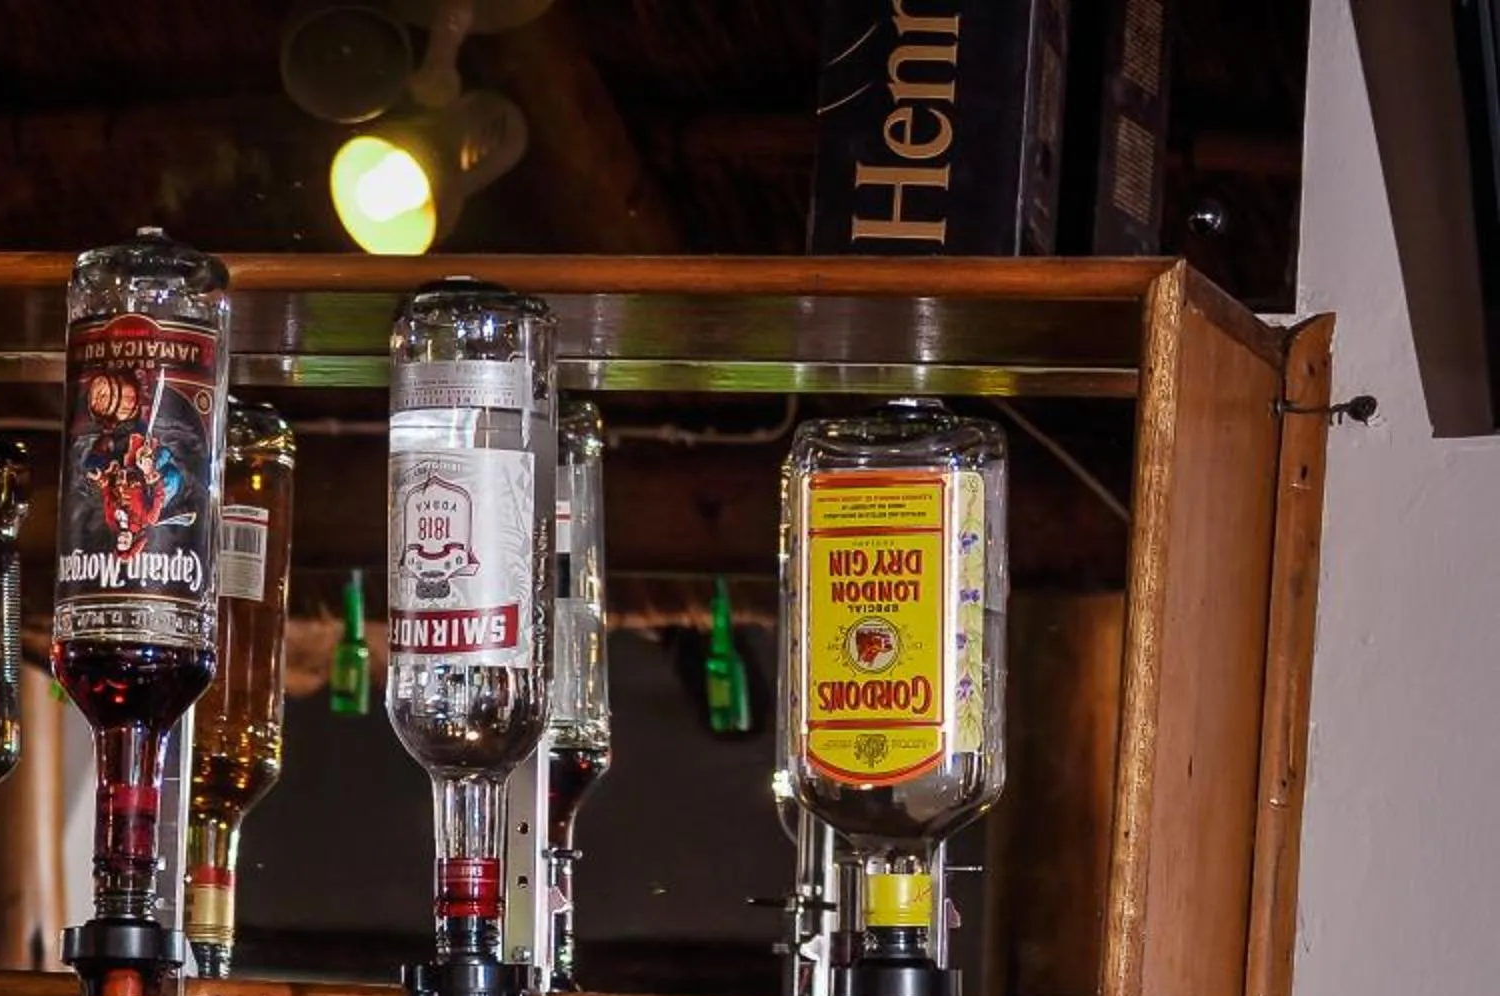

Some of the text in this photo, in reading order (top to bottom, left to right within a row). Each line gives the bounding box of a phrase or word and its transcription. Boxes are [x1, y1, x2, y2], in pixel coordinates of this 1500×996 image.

[82, 340, 200, 365] JAMAICA RU
[106, 358, 156, 369] BLACK
[418, 516, 451, 541] 1818
[125, 548, 203, 592] Captain
[830, 550, 924, 577] DRY GIN
[832, 580, 921, 603] LONDON
[847, 604, 899, 613] SPECIAL
